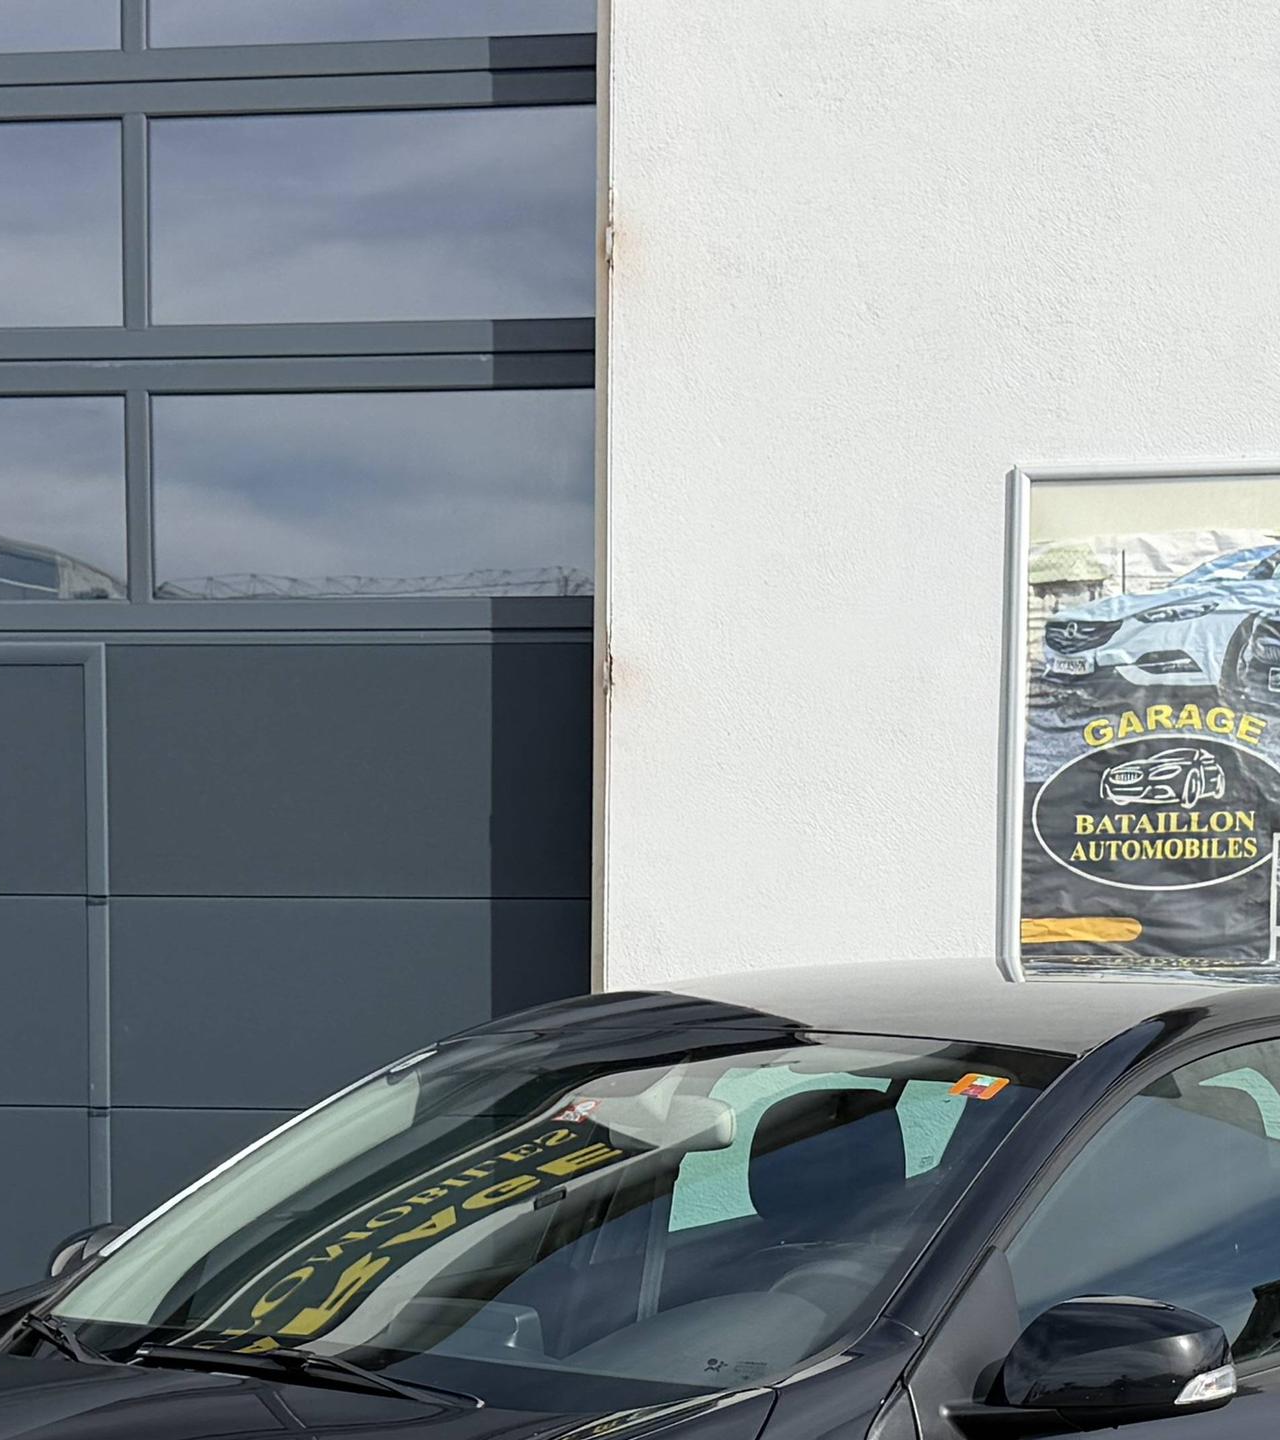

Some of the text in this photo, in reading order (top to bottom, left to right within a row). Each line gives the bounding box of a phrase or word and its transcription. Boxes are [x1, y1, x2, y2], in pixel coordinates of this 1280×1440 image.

[1083, 704, 1268, 746] GARAGE
[1074, 811, 1256, 835] BATAILLON
[1070, 837, 1258, 861] AUTOMOBILES
